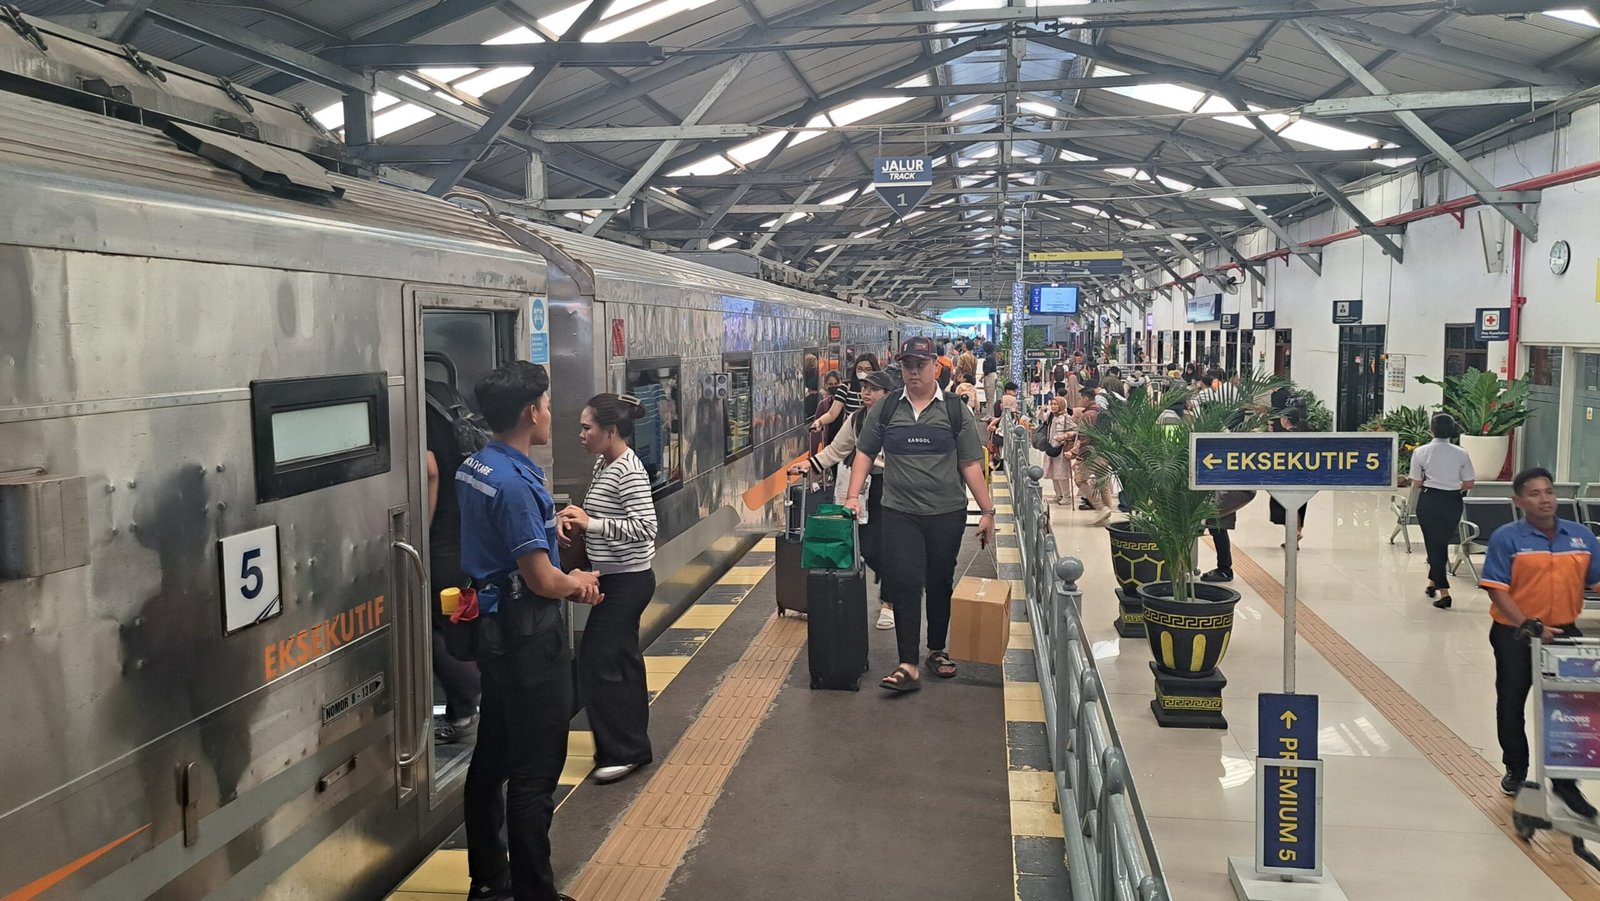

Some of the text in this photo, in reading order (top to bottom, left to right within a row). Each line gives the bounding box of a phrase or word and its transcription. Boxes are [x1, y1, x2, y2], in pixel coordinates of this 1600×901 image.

[881, 159, 924, 171] JALUR
[889, 172, 916, 180] TRACK
[896, 193, 908, 207] 1
[1226, 451, 1380, 470] EKSEKUTIF 5
[240, 547, 263, 600] 5
[263, 595, 385, 682] EKSEKUTIF
[326, 697, 349, 720] NOMOR
[351, 693, 356, 705] 8
[361, 685, 369, 698] 13
[1279, 737, 1298, 861] PREMIUM 5
